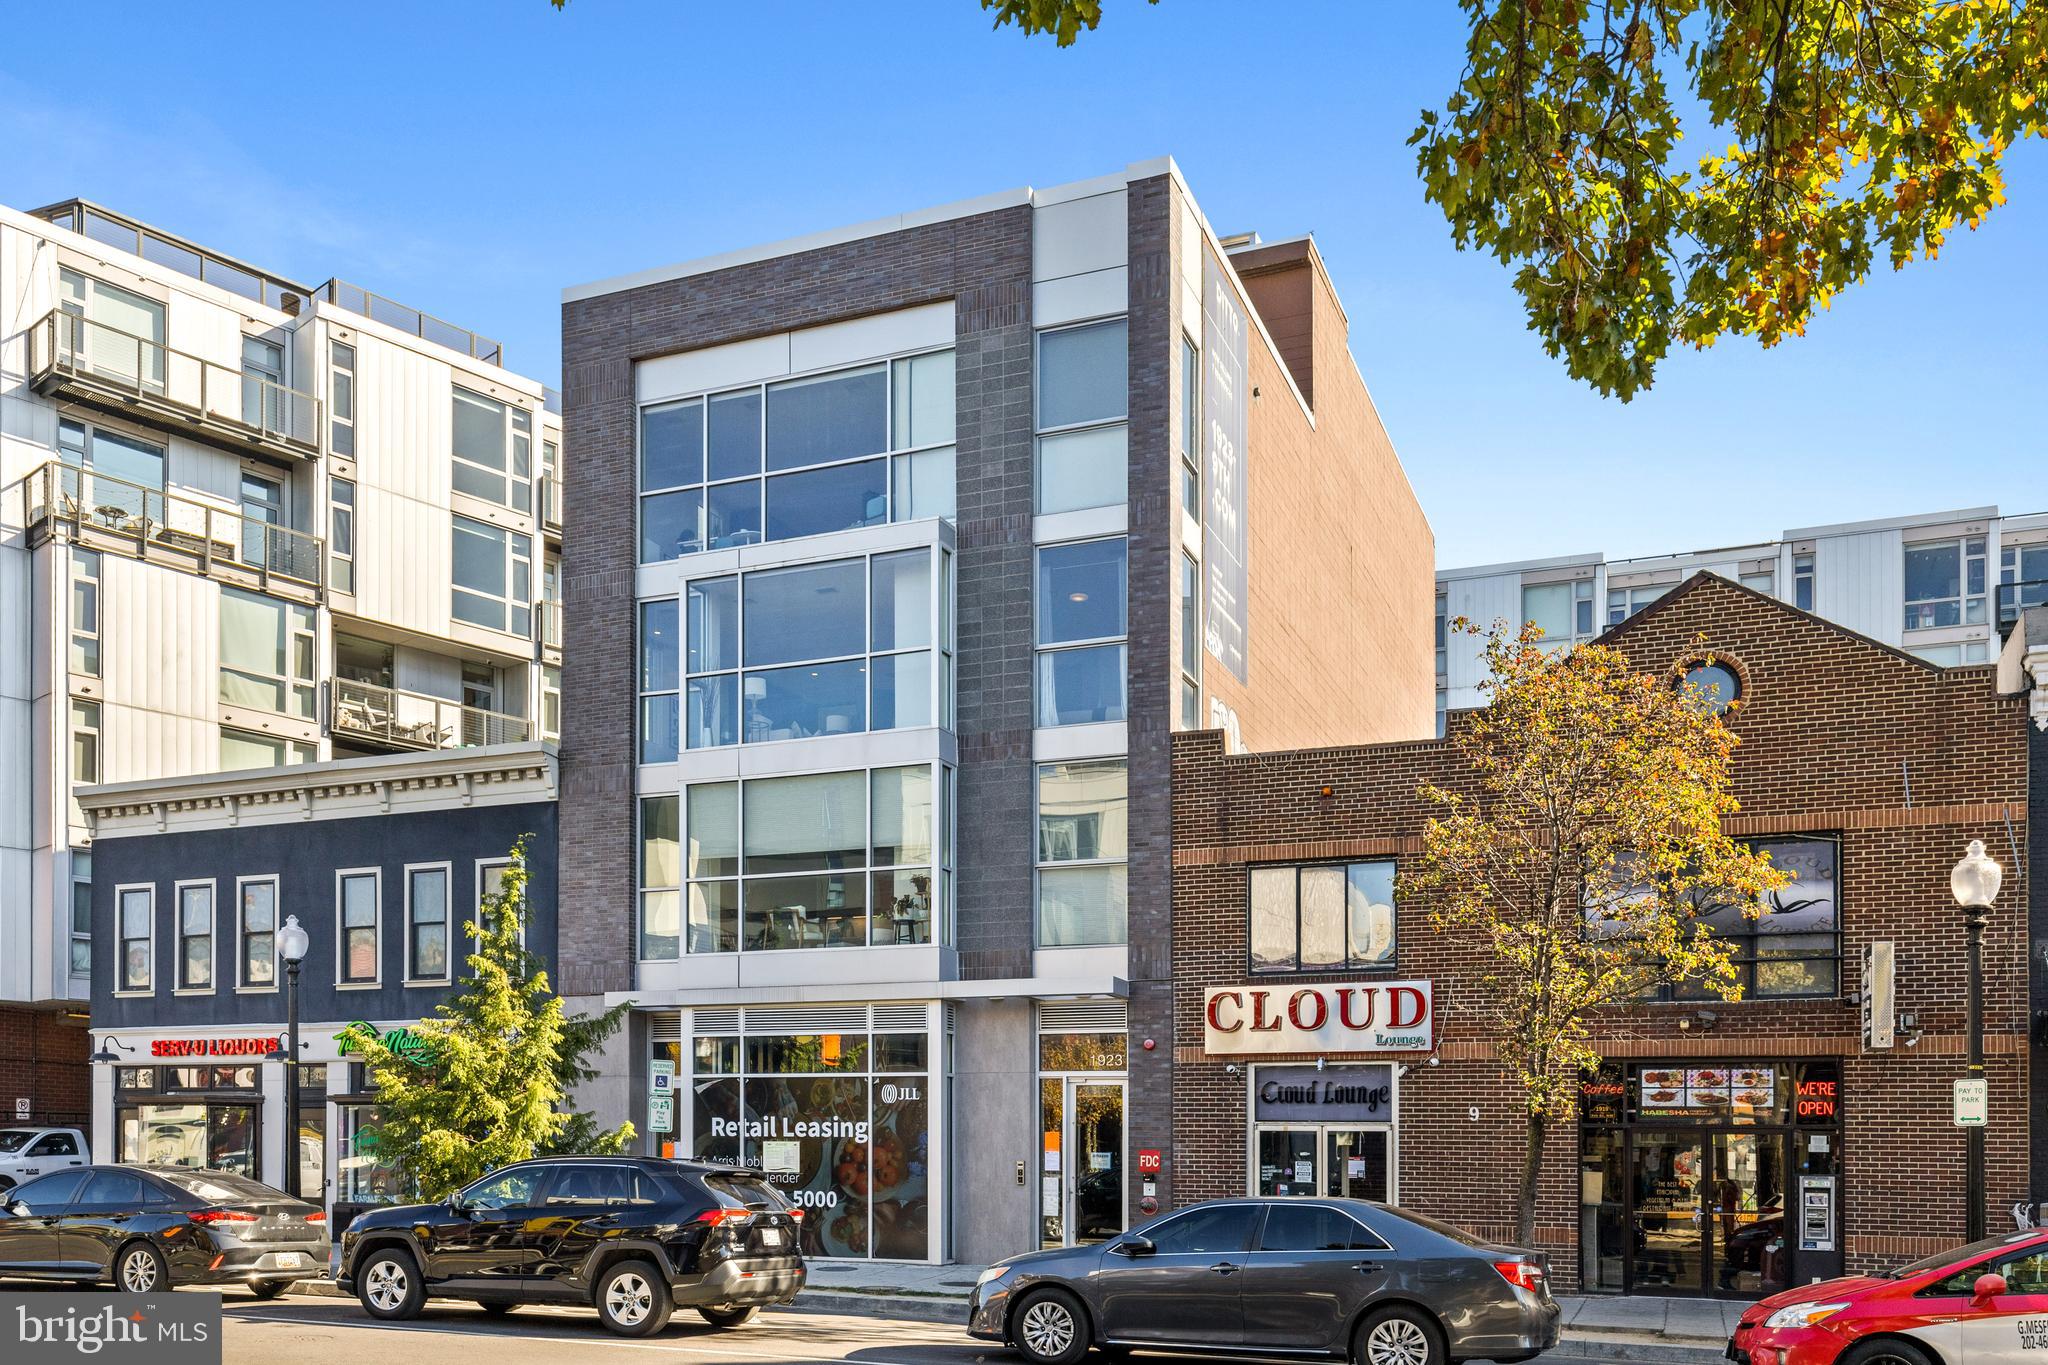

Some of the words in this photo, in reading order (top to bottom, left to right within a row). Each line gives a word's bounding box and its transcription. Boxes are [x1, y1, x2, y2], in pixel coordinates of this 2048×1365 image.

[1207, 986, 1428, 1032] CLOUD
[151, 1040, 206, 1057] SERV-U
[209, 1037, 279, 1055] LIQUORS
[1375, 1033, 1426, 1048] Lounge
[1090, 1054, 1123, 1067] 1923
[898, 1087, 920, 1101] JLL
[1583, 1084, 1624, 1095] Coffee
[1796, 1081, 1836, 1096] WE'RE
[1322, 1081, 1390, 1113] Lounge
[1641, 1109, 1690, 1117] HABESHA
[1798, 1101, 1833, 1116] OPEN
[711, 1115, 777, 1137] Retail
[782, 1115, 870, 1144] Leasing
[1140, 1154, 1160, 1168] FDC
[2017, 1320, 2048, 1335] G.MESF
